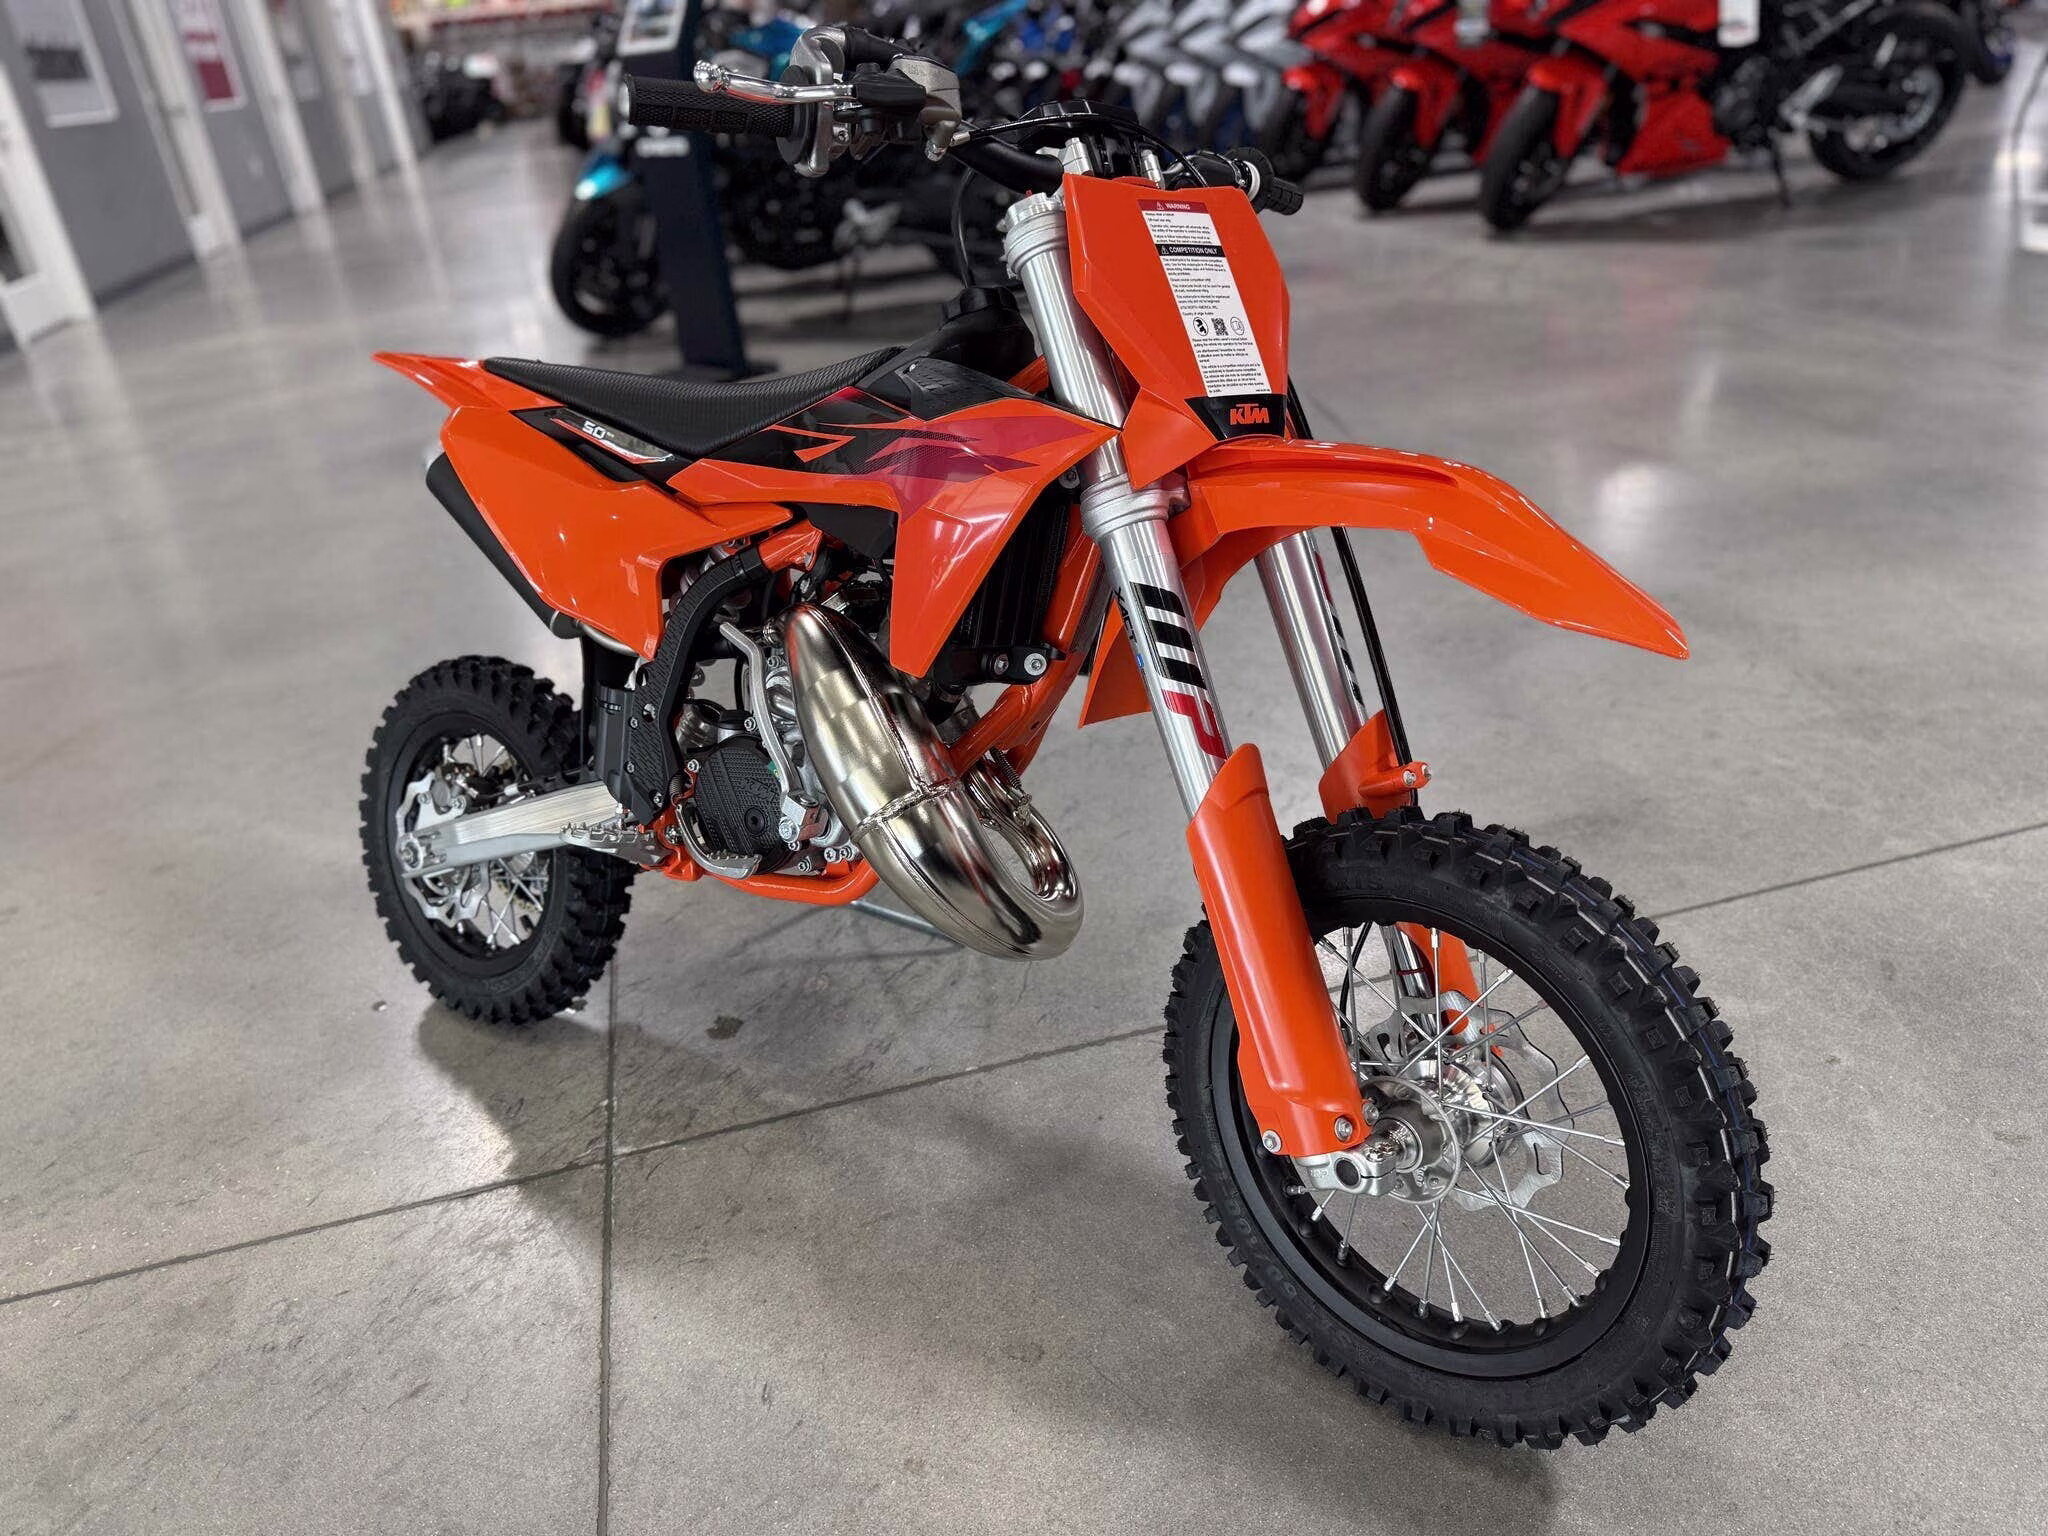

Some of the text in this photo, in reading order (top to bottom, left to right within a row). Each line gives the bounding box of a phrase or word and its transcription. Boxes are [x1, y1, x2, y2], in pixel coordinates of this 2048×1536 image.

[1165, 202, 1190, 210] WARNING
[1168, 246, 1218, 255] COMPETITION ONLY
[1229, 403, 1270, 425] KTM
[582, 420, 606, 439] 50
[1113, 586, 1138, 643] XACT
